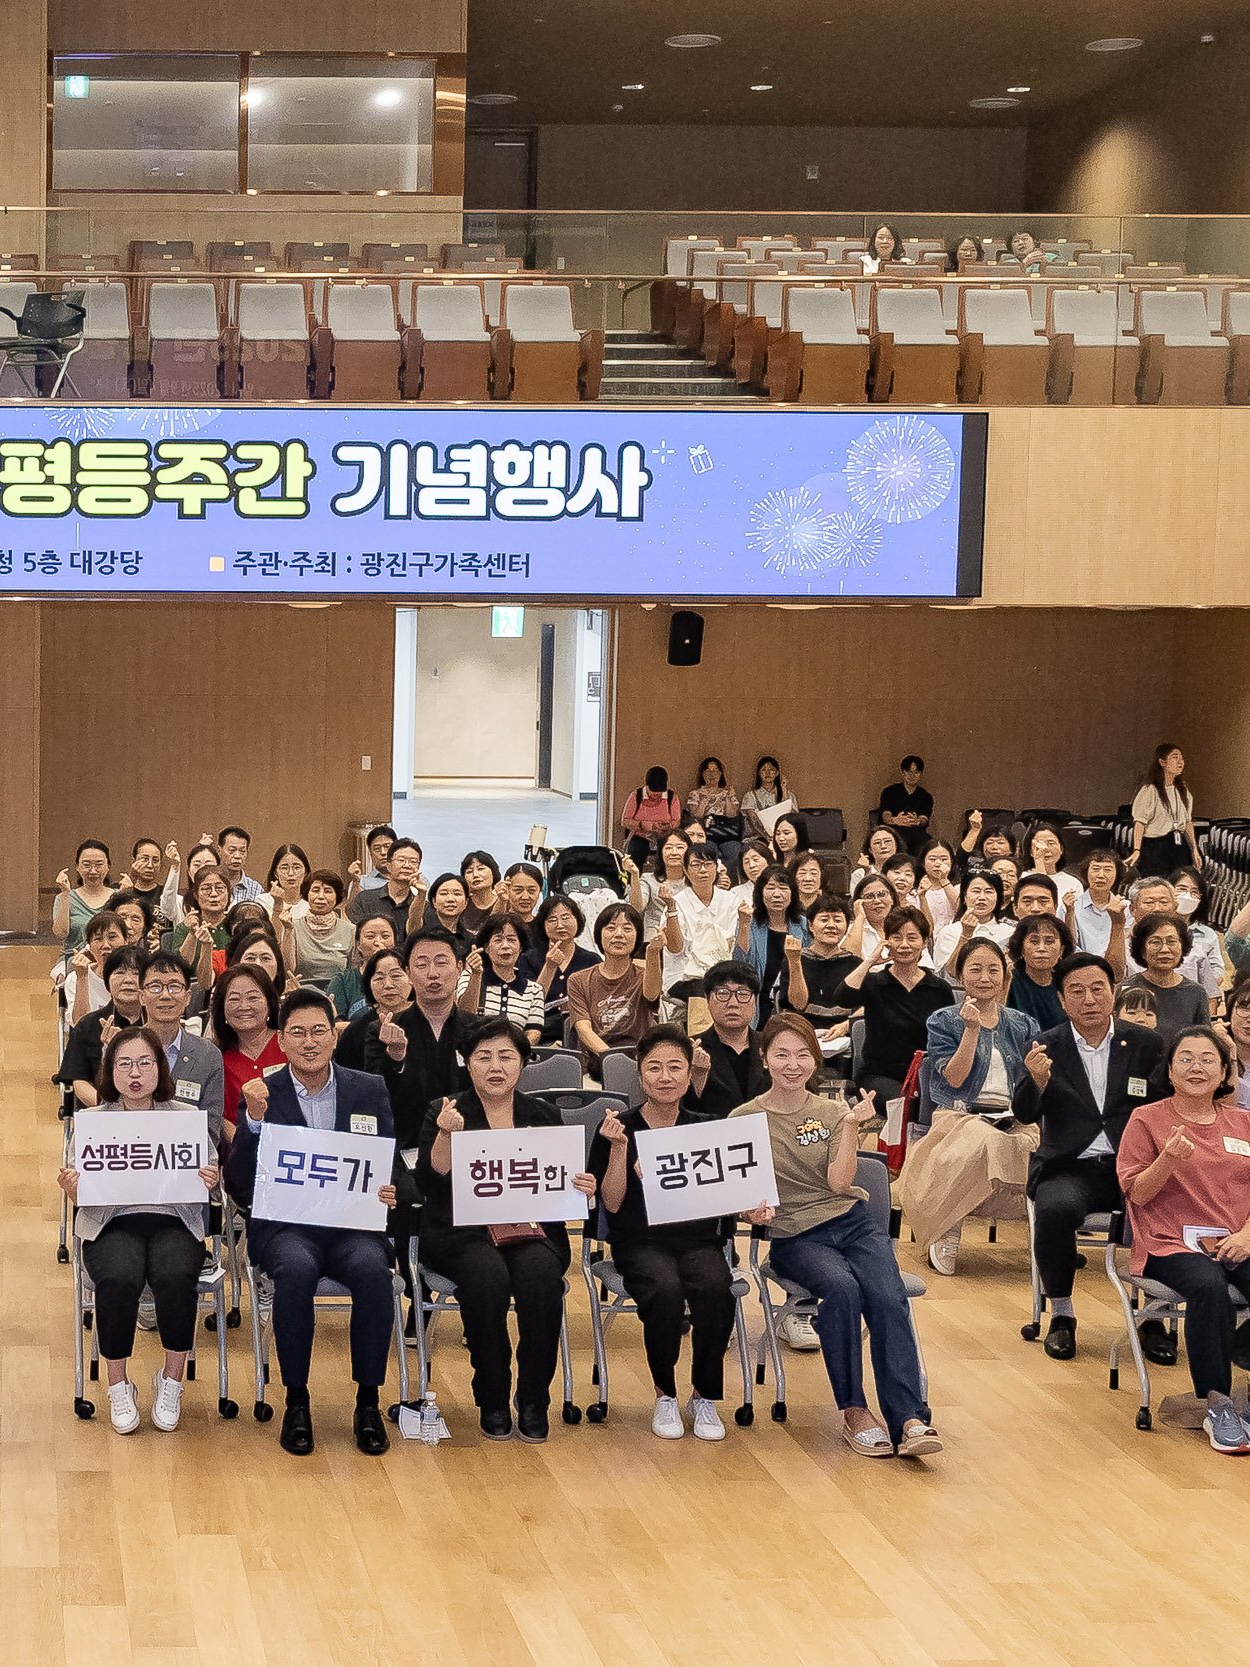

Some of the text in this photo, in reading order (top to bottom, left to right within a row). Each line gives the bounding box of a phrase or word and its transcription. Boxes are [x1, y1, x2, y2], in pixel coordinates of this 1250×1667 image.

[330, 440, 653, 522] 기념행사
[23, 550, 62, 575] 5층
[70, 550, 143, 576] 대강당
[233, 551, 336, 577] 주관·주최
[360, 552, 531, 579] 광진구가족센터
[81, 1141, 201, 1172] 성평등사회
[275, 1150, 373, 1193] 모두가
[656, 1142, 758, 1190] 광진구
[469, 1157, 567, 1197] 행복한
